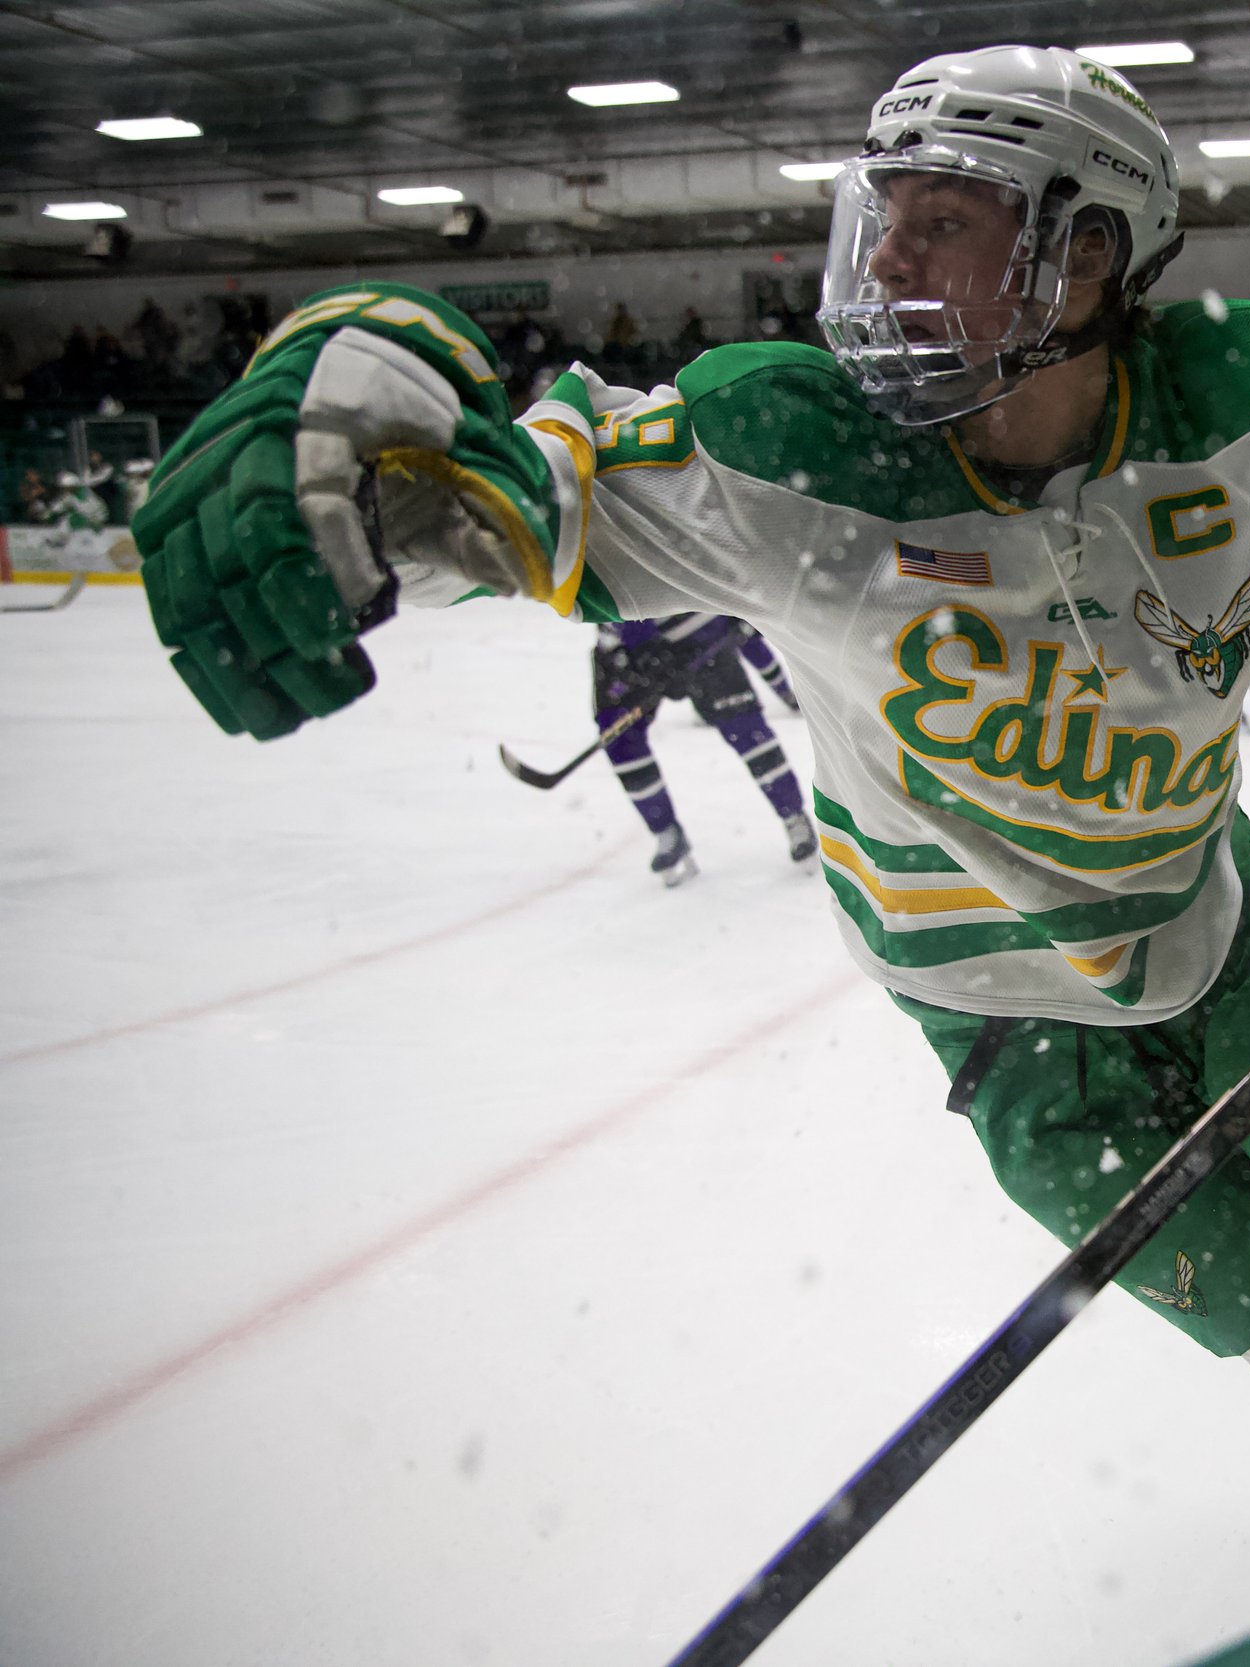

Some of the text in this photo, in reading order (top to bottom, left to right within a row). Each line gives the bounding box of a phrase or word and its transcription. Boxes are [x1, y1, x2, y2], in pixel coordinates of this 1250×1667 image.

[878, 94, 933, 118] CCM
[1092, 149, 1149, 185] CCM
[1143, 484, 1236, 560] C
[879, 603, 1241, 816] Edina
